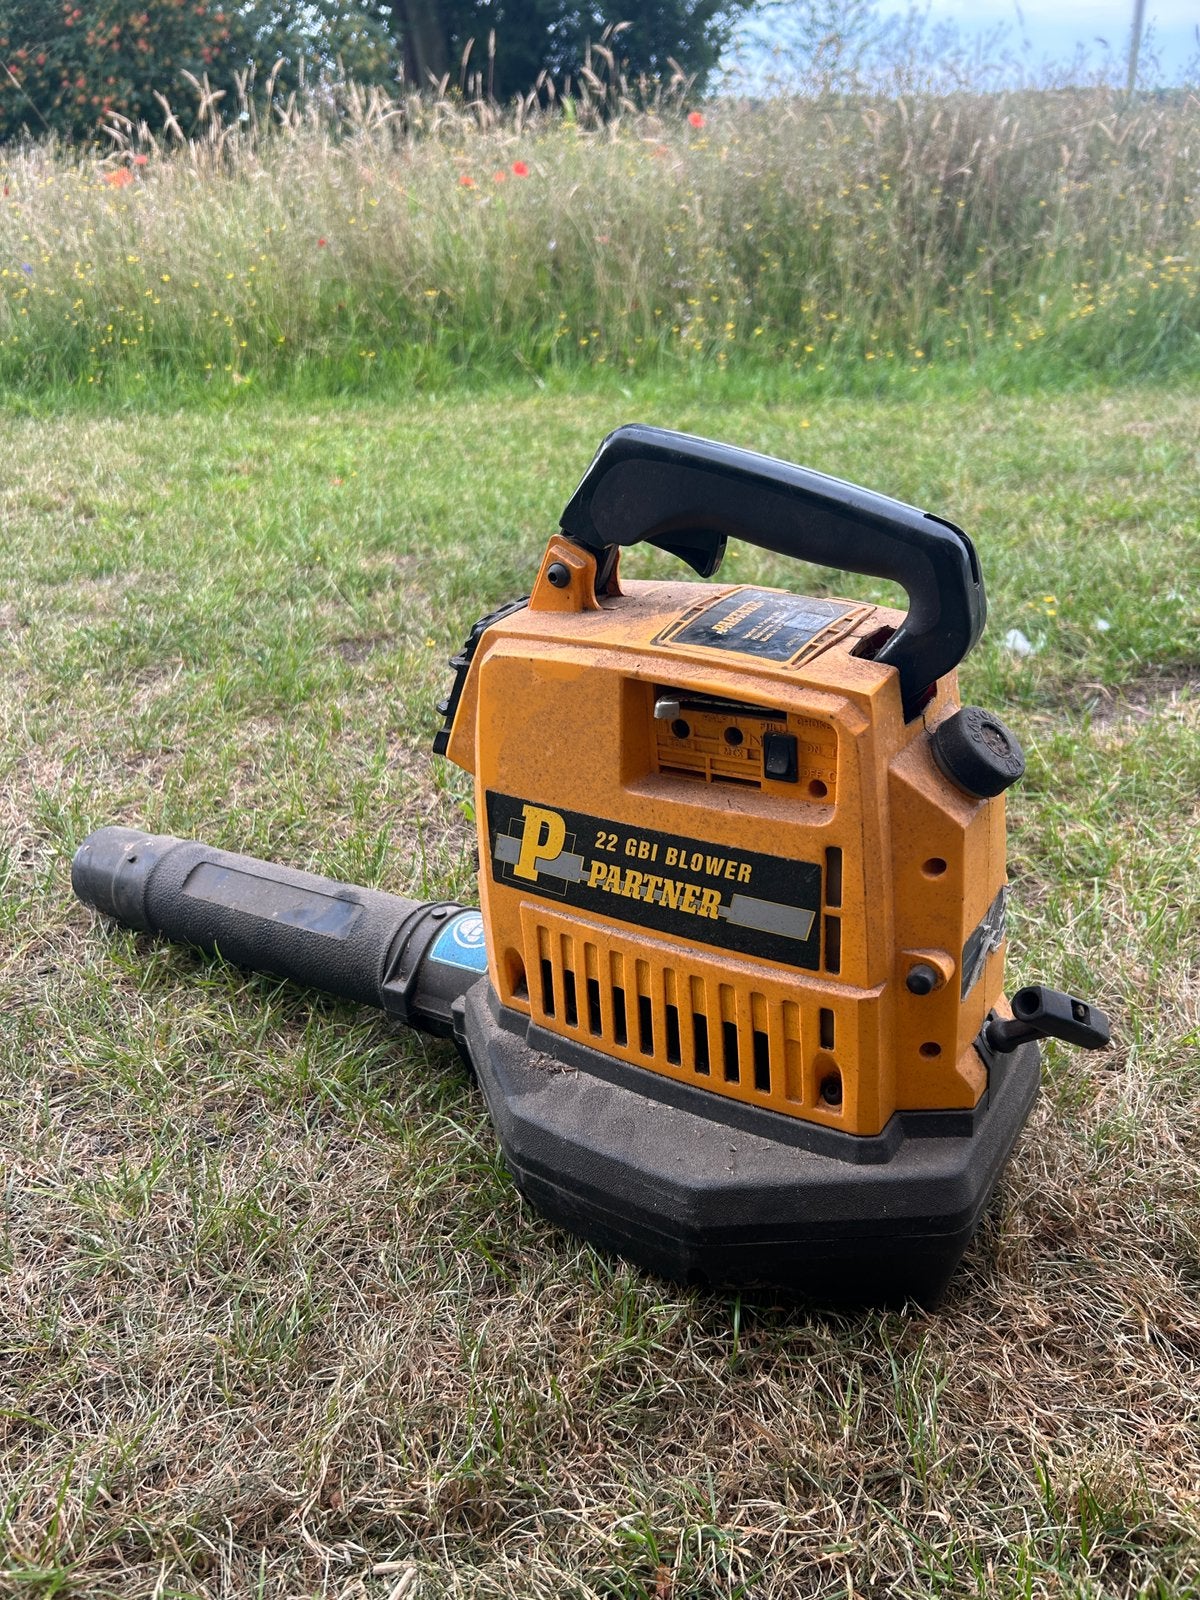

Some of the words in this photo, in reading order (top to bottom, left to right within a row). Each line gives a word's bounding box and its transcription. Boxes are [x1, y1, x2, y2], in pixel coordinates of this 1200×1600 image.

[513, 804, 566, 881] P
[595, 831, 618, 853] 22
[625, 838, 659, 862] GBI
[665, 846, 753, 883] BLOWER
[587, 860, 723, 920] PARTNER
